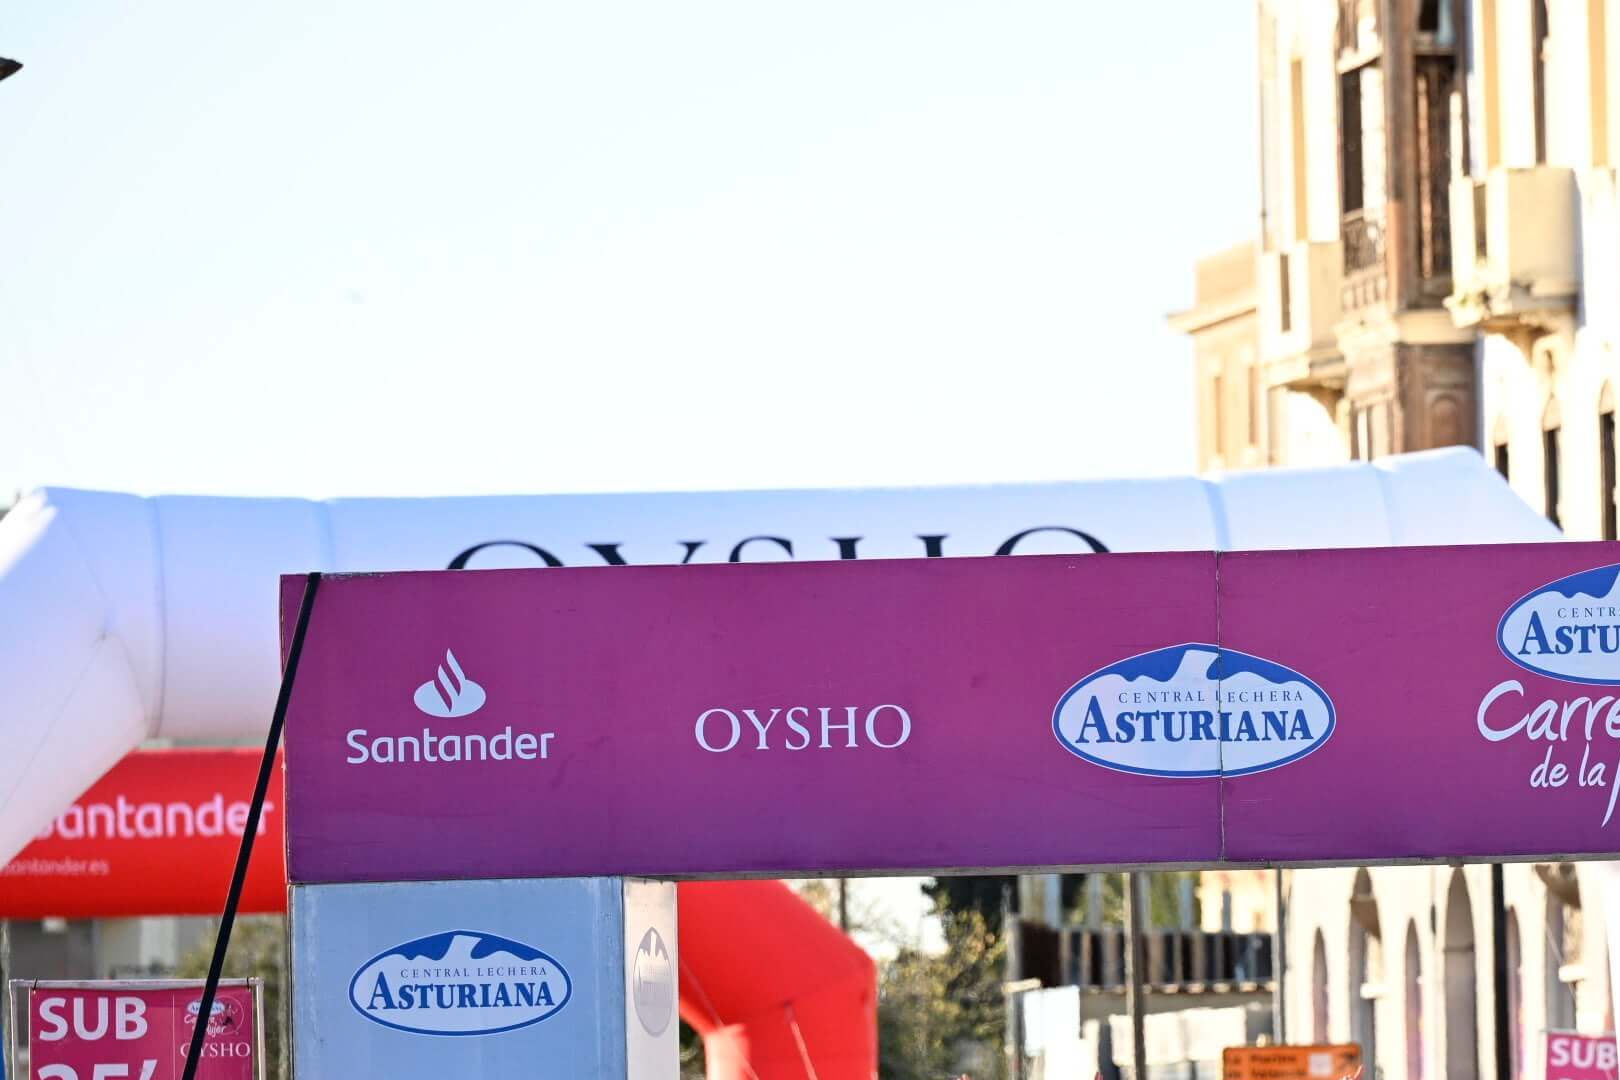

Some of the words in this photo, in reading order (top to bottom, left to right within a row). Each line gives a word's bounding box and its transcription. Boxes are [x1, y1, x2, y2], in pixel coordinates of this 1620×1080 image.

[1118, 690, 1206, 704] CENTRAL
[1215, 689, 1304, 703] LECHERA
[694, 704, 912, 753] OYSHO
[1075, 695, 1314, 743] ASTURIANA
[346, 726, 555, 764] Santander
[1530, 745, 1569, 788] de
[1578, 744, 1606, 787] la
[47, 794, 274, 839] antander
[367, 971, 555, 1011] ASTURIANA
[401, 967, 470, 979] CENTRAL
[477, 966, 548, 978] LECHERA
[39, 996, 149, 1041] SUB
[1550, 1037, 1617, 1071] SUB
